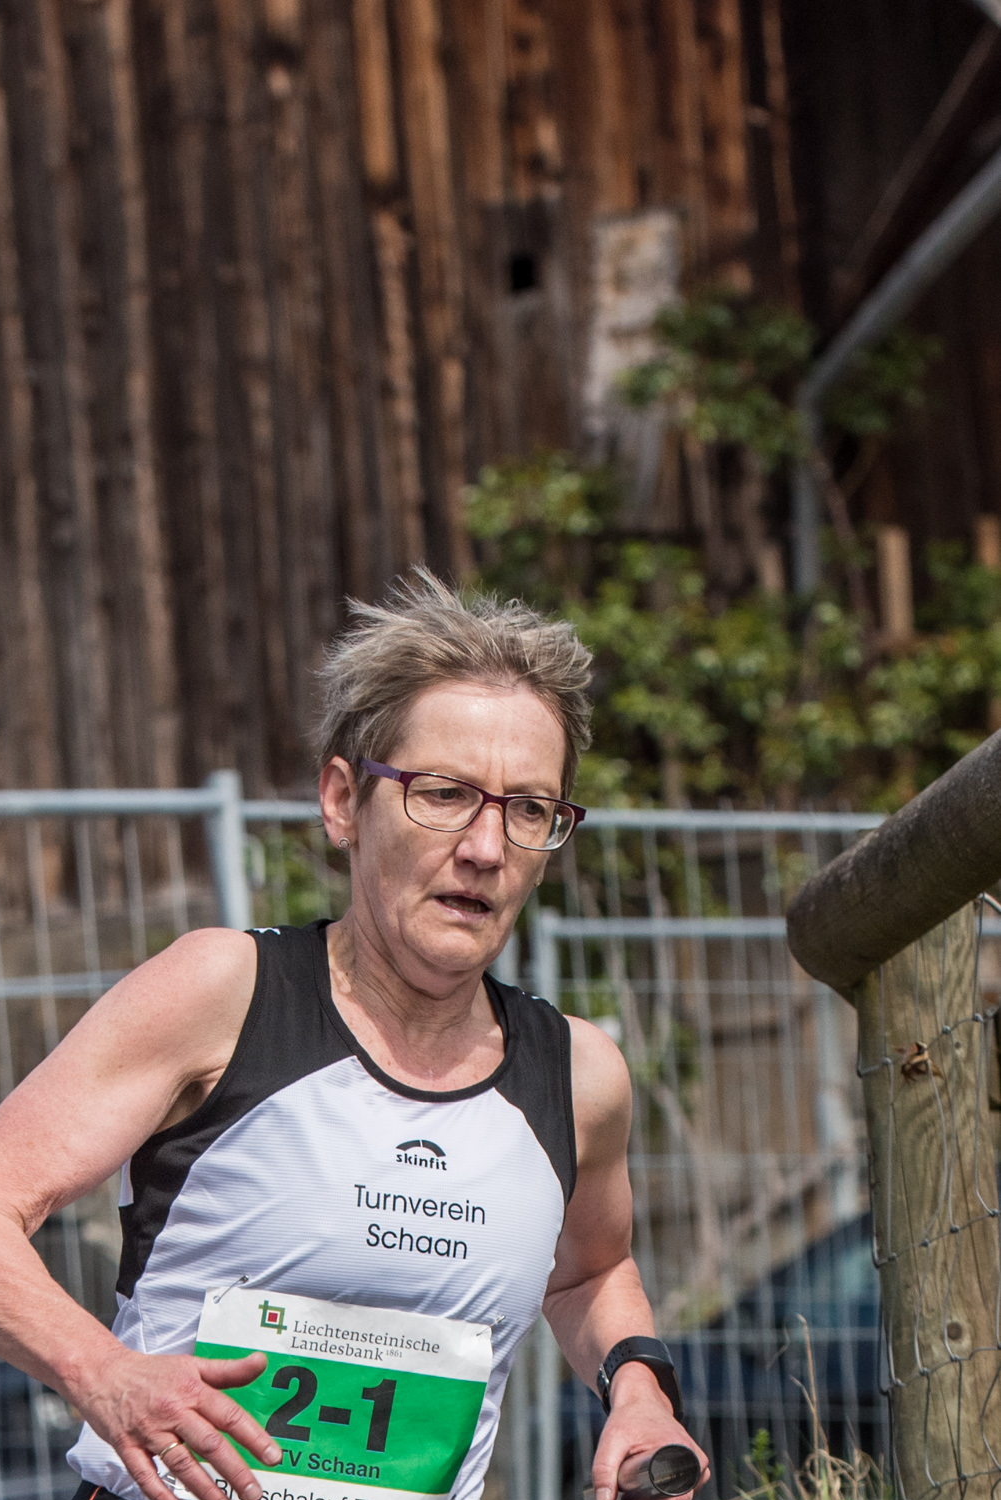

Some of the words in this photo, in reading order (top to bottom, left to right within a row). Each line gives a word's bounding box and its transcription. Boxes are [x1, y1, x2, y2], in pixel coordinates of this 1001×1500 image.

[395, 1153, 447, 1171] skinfit
[354, 1184, 486, 1225] Turnverein
[366, 1223, 468, 1260] Schaan
[291, 1336, 384, 1361] Landesbank
[385, 1349, 403, 1359] 1861
[293, 1320, 440, 1354] Liechtensteinische
[264, 1365, 397, 1453] 2-1
[307, 1453, 381, 1479] Schaan
